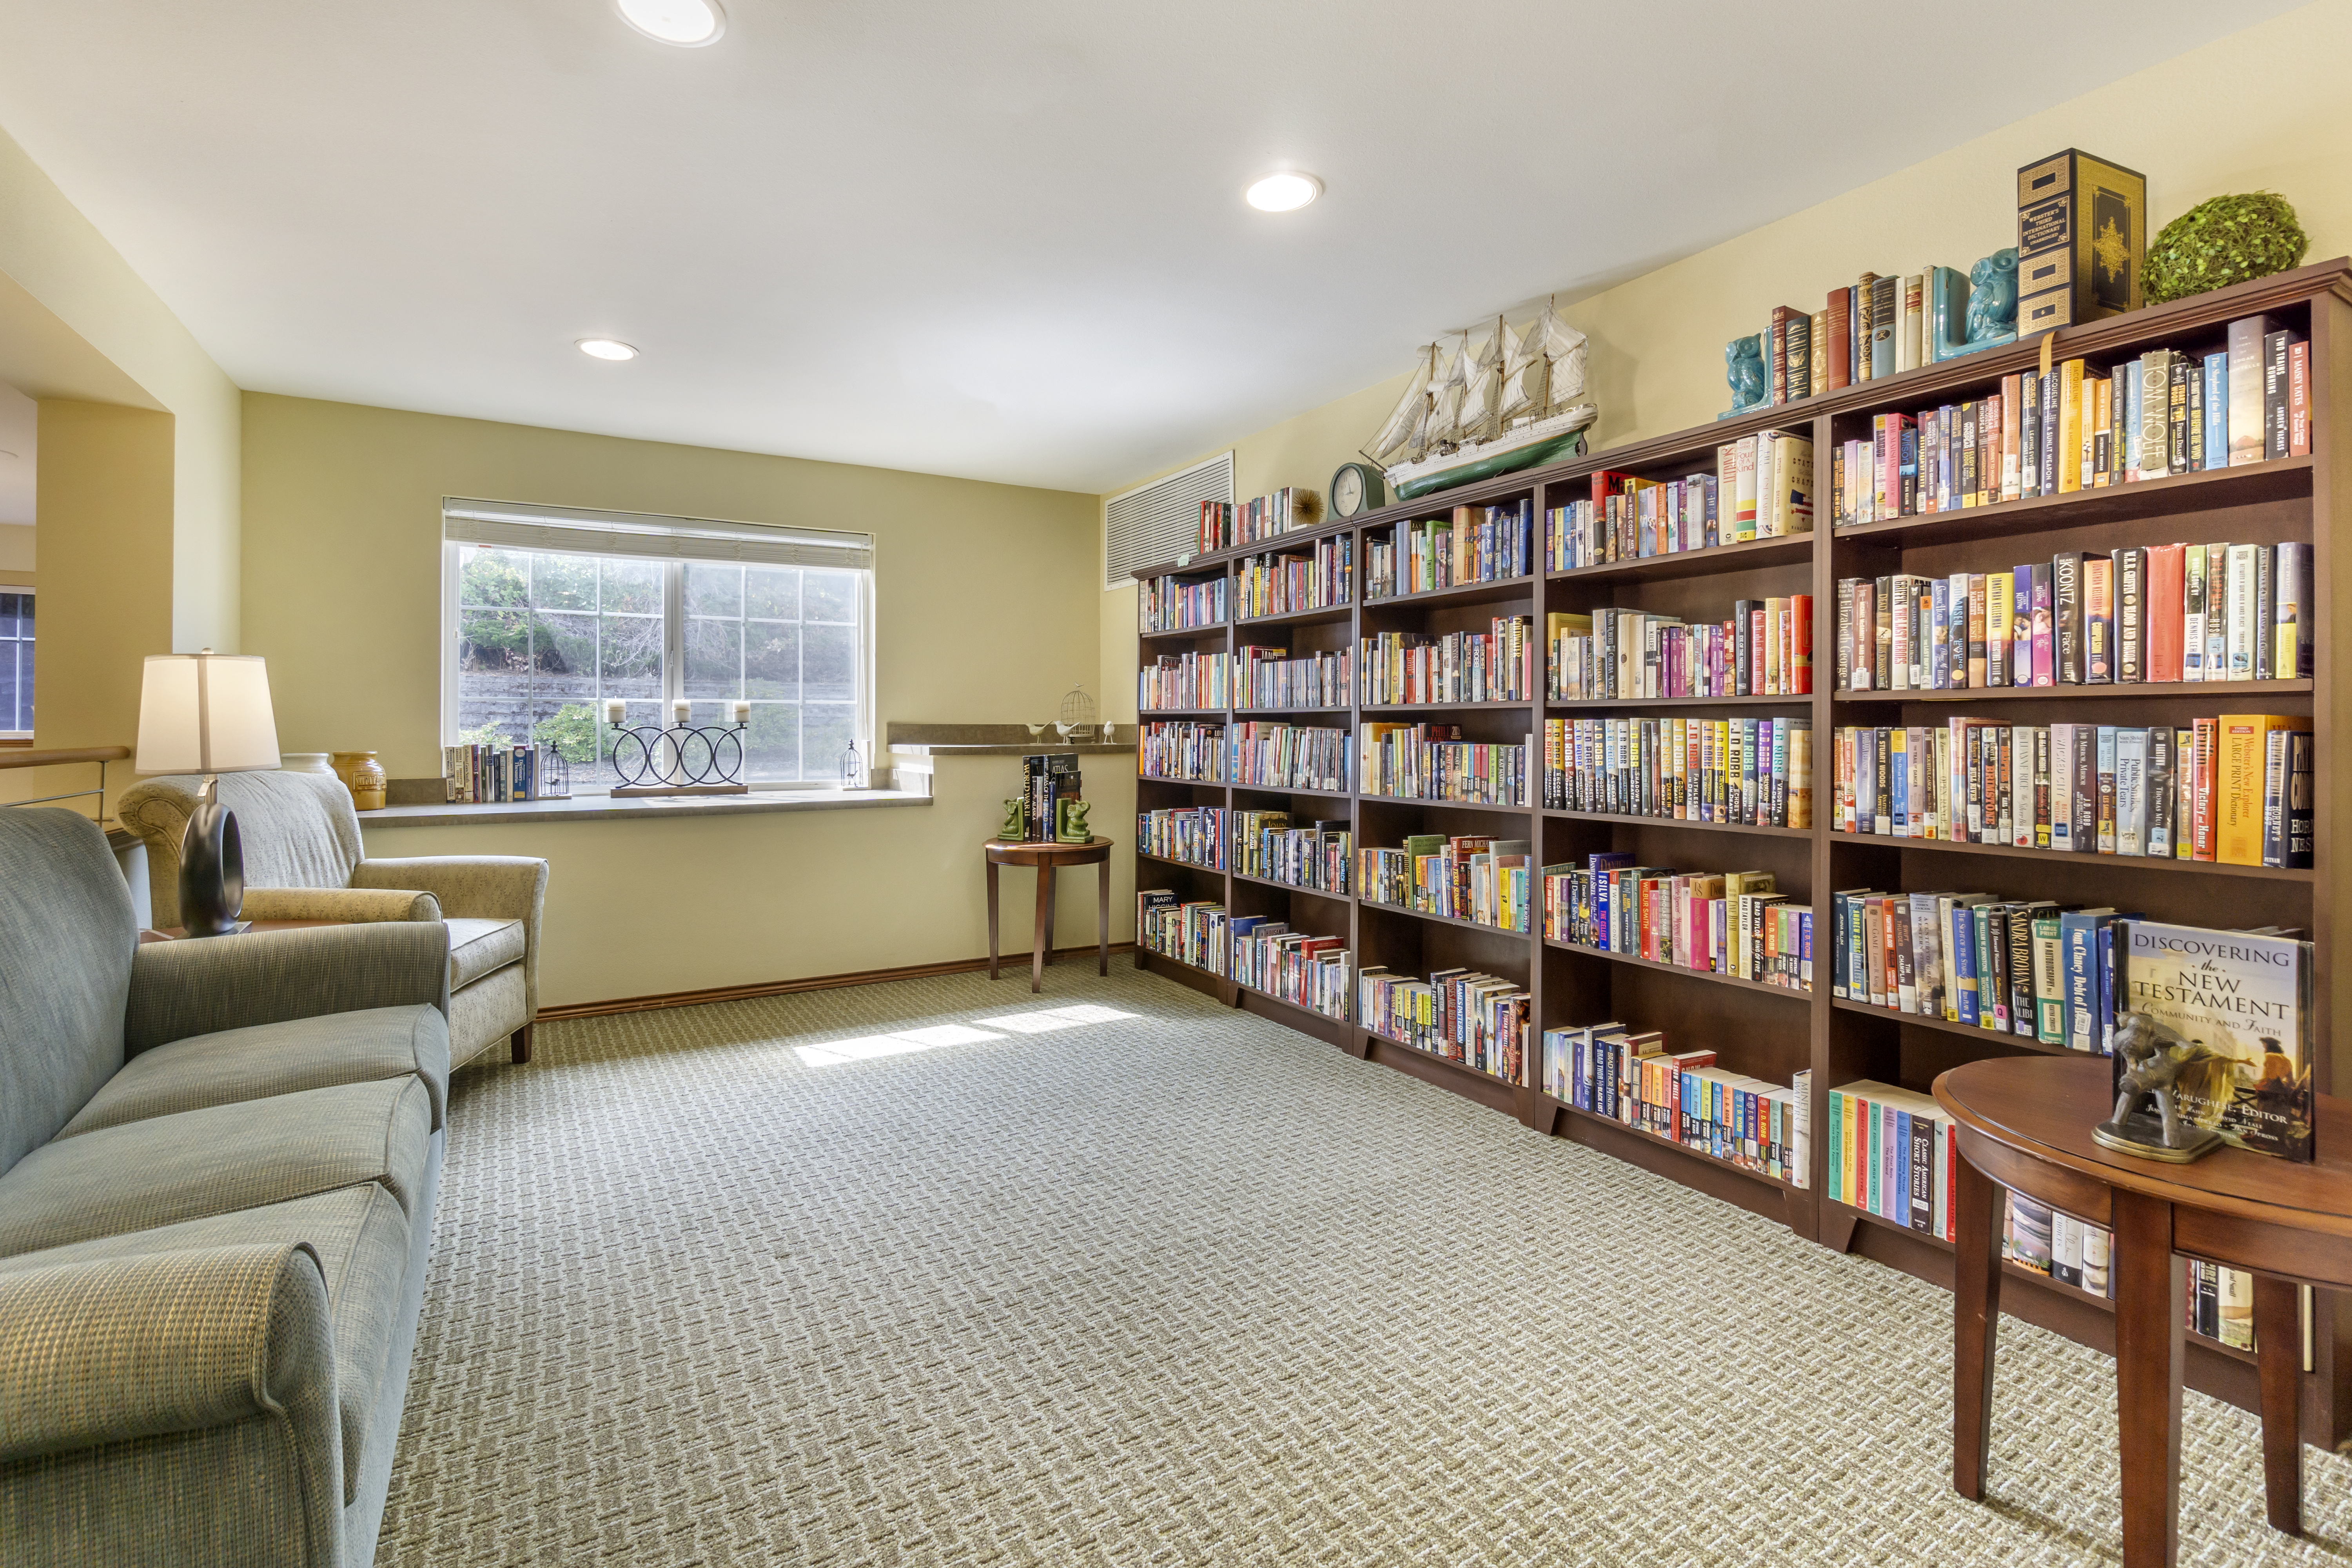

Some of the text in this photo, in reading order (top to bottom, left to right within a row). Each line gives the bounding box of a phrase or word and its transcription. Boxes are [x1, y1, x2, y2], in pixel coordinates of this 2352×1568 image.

[2023, 218, 2066, 237] INTERNATIONAL
[2028, 225, 2060, 240] DICTIONARY
[2029, 209, 2059, 223] WEBSTER'S
[2036, 217, 2053, 226] THIRD
[2030, 233, 2058, 245] UNABRIDGED
[2276, 337, 2285, 375] TWO TRAINS
[2209, 368, 2220, 394] Shepherd
[2268, 366, 2276, 394] RUNNING
[2142, 362, 2166, 459] TOM WOLFE
[1737, 451, 1754, 459] Four
[1902, 432, 1911, 465] Wilson
[1721, 448, 1736, 483] SCARLETT
[1737, 462, 1754, 473] Kind
[2059, 562, 2074, 605] KOONTZ
[2092, 564, 2103, 611] JONATHAN KELLERMAN
[1953, 585, 1963, 625] JOHANSEN
[1837, 600, 1852, 677] Elizabeth George
[1895, 580, 1907, 664] GRIFFIN THE LAST HEROES
[2092, 622, 2102, 653] COMPULSION
[2123, 606, 2136, 662] BLOOD AND HONOR
[2062, 632, 2071, 653] Face
[2120, 759, 2129, 807] Private Tears
[2129, 759, 2140, 812] Public Smiles,
[2227, 738, 2241, 827] LARGE PRINT Dictionary
[2243, 738, 2254, 818] Webster's New Explorer
[1985, 765, 1994, 825] BRIMSTONE
[2197, 788, 2209, 814] Victory
[2198, 825, 2209, 848] Honor
[1599, 880, 1607, 902] SILVA
[2011, 911, 2029, 985] SANDRA BROWN
[2134, 934, 2289, 966] DISCOVERING
[2045, 949, 2054, 987] AUTOBIOGRAPHY
[2071, 929, 2087, 1005] Tom Clancy Debt of
[2179, 971, 2241, 993] NEW
[2201, 960, 2218, 972] the
[2014, 1007, 2032, 1019] ALIBI
[2016, 996, 2029, 1007] THE
[2134, 981, 2289, 1020] TESTAMENT
[2142, 1002, 2281, 1036] COMMUNITY AND FAITH
